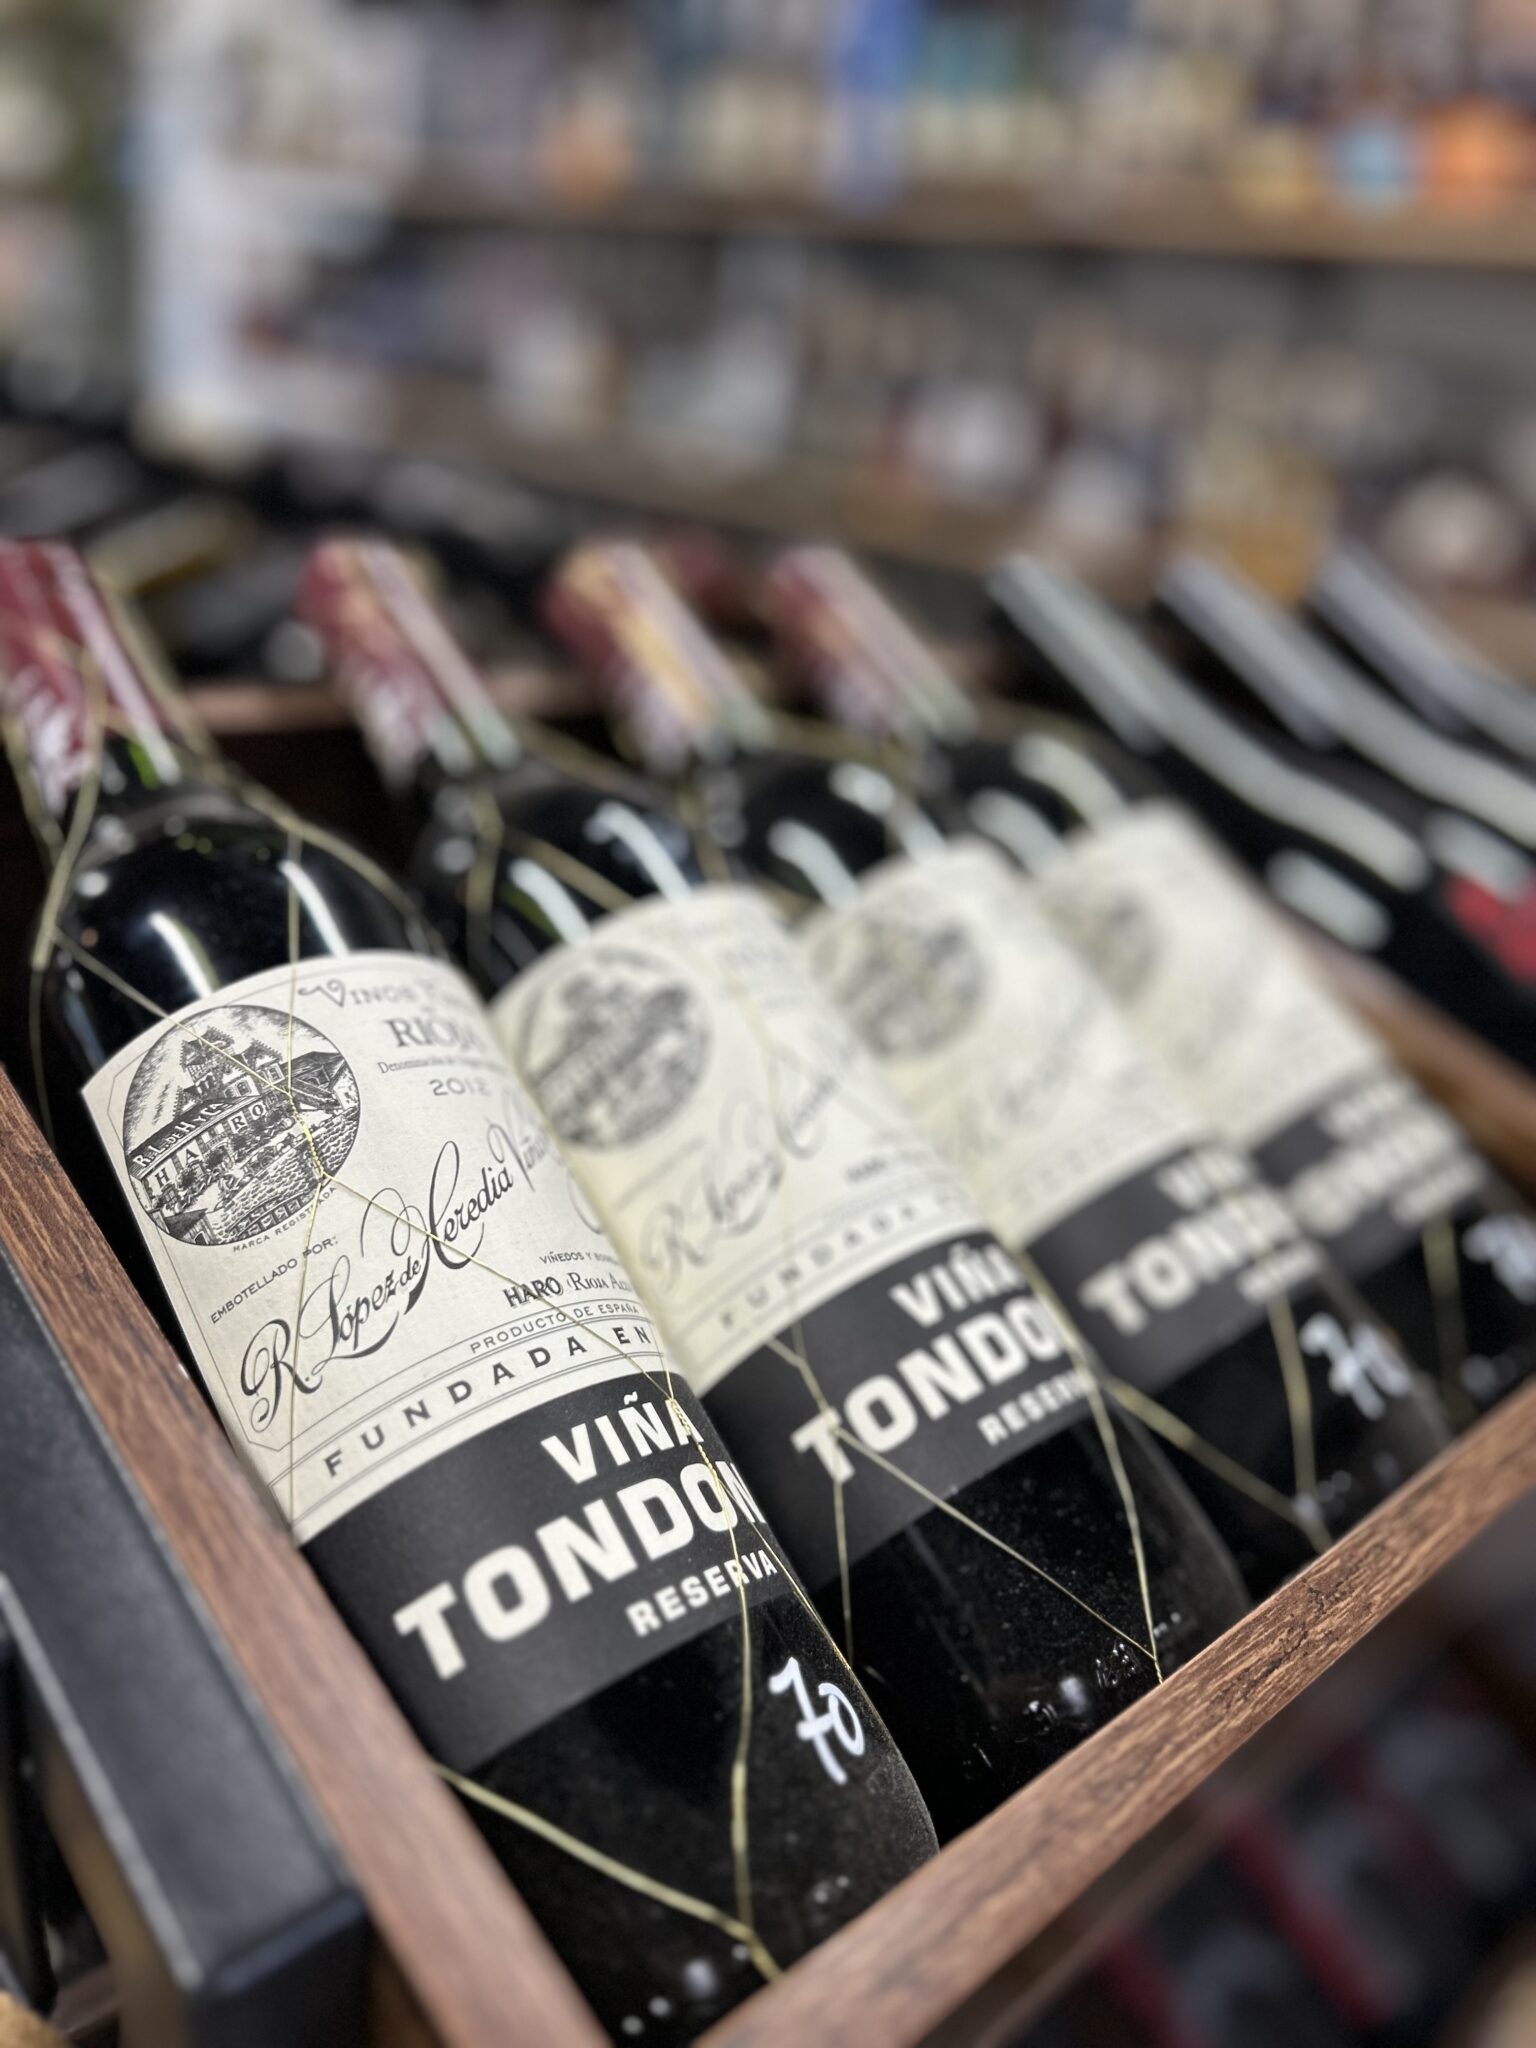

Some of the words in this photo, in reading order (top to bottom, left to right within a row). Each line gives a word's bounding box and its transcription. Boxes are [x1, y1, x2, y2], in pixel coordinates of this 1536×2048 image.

[428, 1077, 491, 1097] 2012
[233, 1234, 271, 1252] MARCA
[360, 1140, 514, 1316] Heredia
[540, 1251, 585, 1265] VIÑEDOS
[210, 1258, 298, 1324] EMBOTELLADO
[302, 1235, 339, 1258] POR:
[399, 1255, 421, 1287] de
[503, 1276, 564, 1308] HARO
[470, 1312, 567, 1354] PRODUCTO
[573, 1305, 594, 1319] DE
[599, 1301, 640, 1315] ESPAÑA
[323, 1334, 588, 1478] FUNDADA
[612, 1326, 651, 1345] EN
[541, 1391, 705, 1484] VIÑA
[626, 1549, 779, 1638] RESERVA
[769, 1656, 866, 1785] 70
